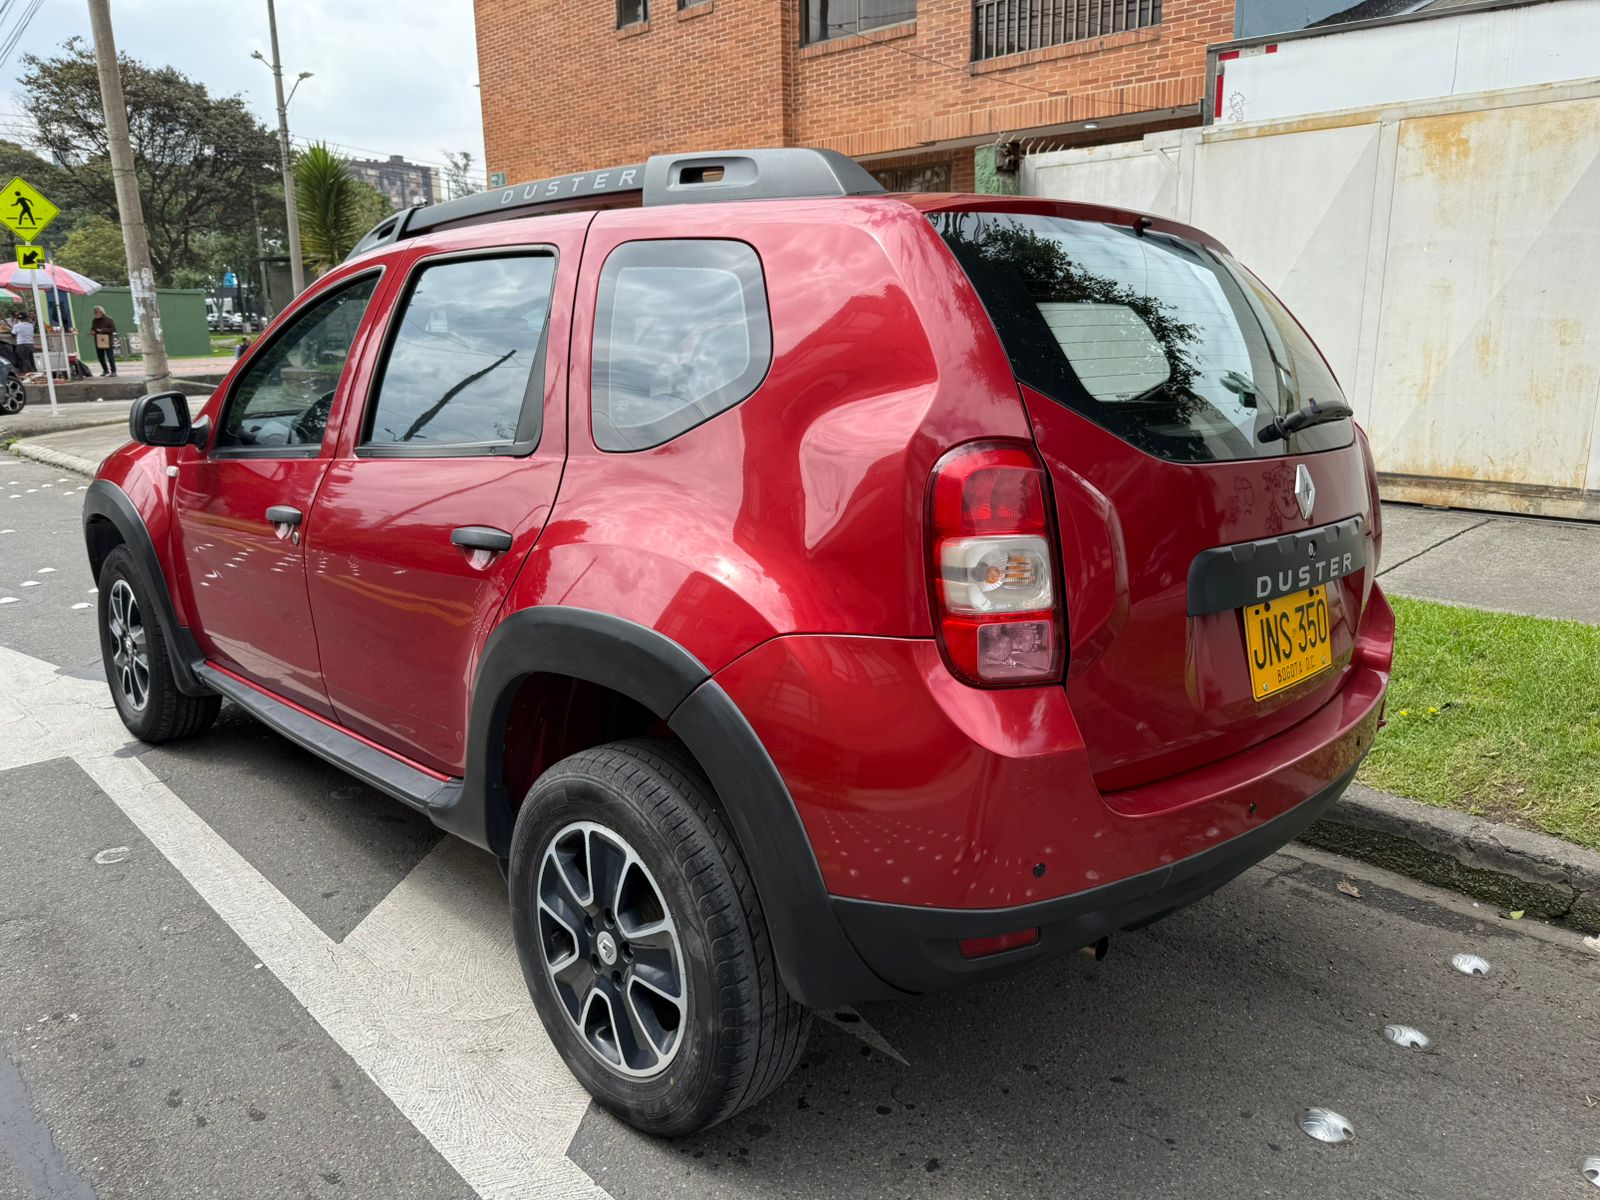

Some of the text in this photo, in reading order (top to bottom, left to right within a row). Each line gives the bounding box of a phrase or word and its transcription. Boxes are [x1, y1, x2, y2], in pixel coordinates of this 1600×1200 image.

[501, 169, 637, 205] DUSTER
[1256, 552, 1352, 598] DUSTER
[1254, 598, 1328, 669] JNS 350
